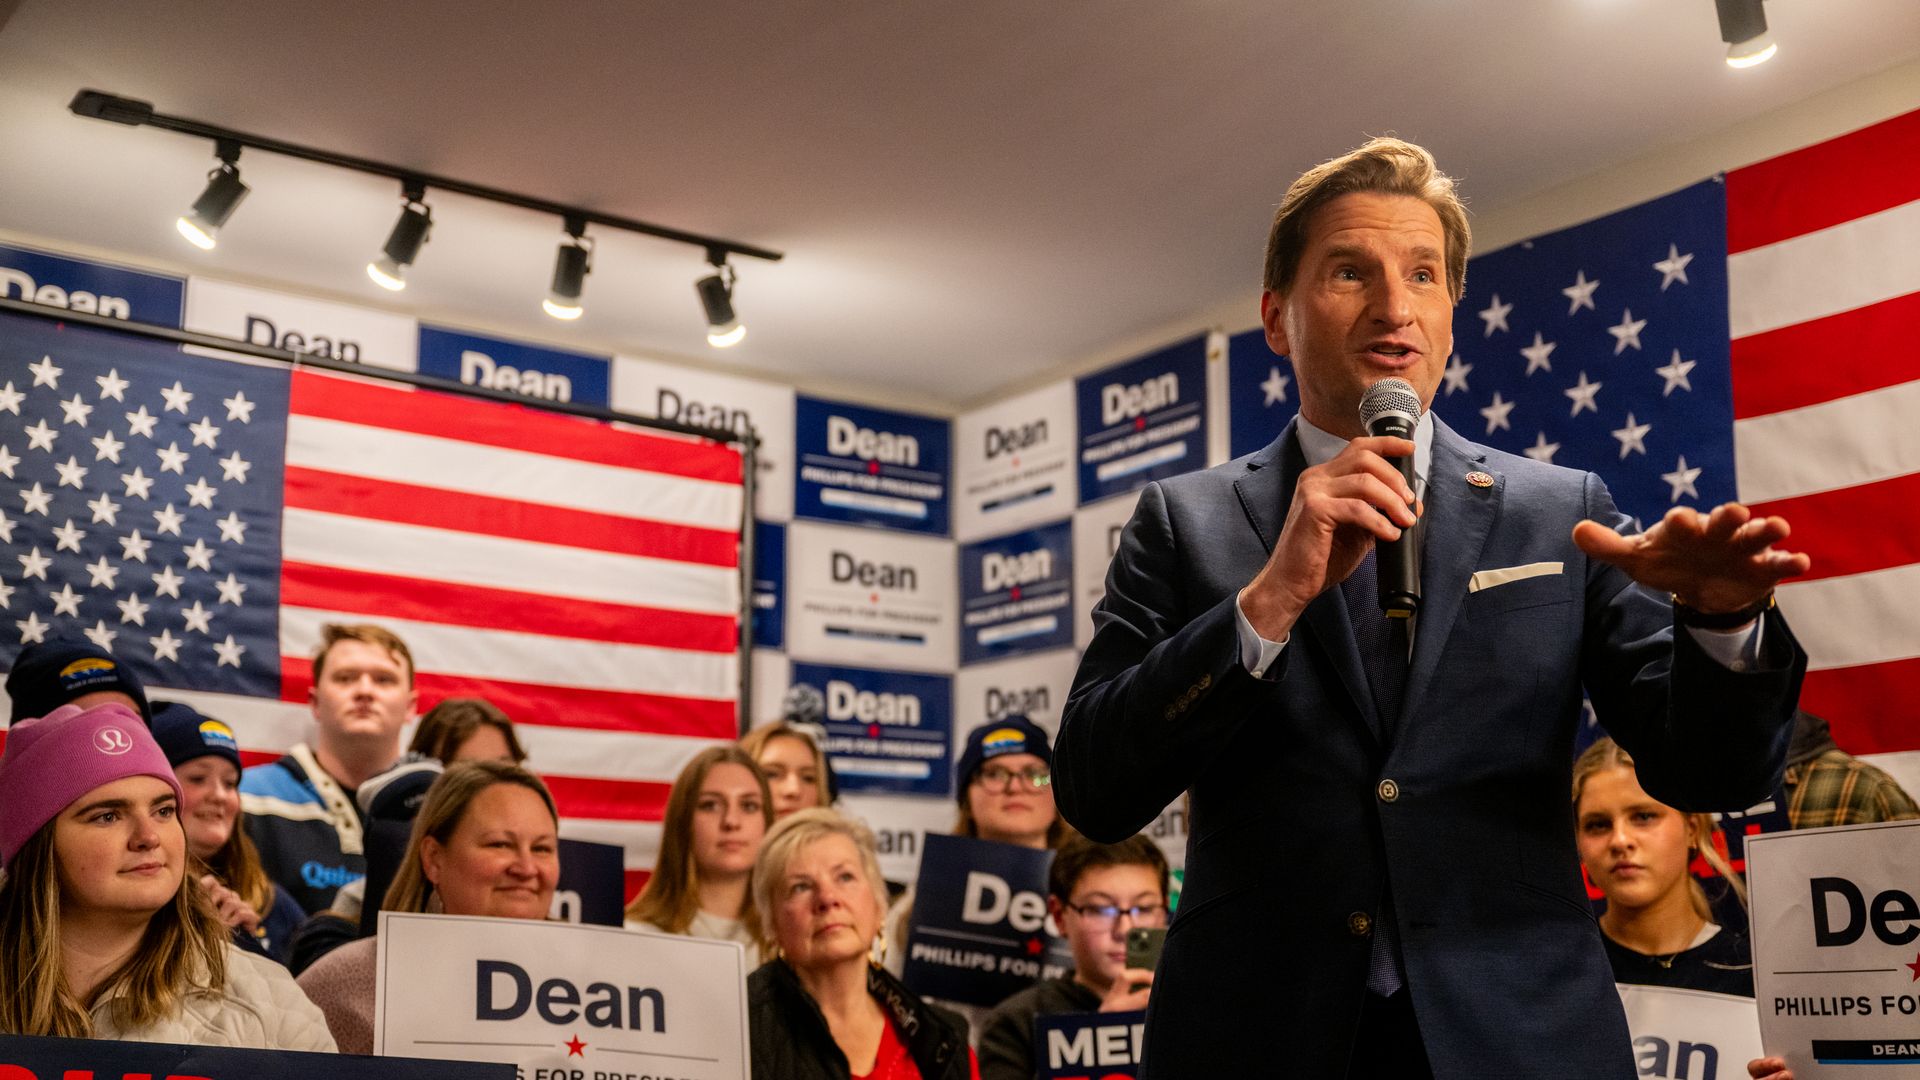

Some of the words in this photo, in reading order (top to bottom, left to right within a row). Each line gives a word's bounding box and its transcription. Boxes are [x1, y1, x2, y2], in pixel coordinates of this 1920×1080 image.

[460, 350, 572, 403] Dean
[1102, 372, 1179, 426] Dean
[827, 415, 919, 467] Dean
[985, 418, 1047, 460] Dean
[831, 550, 917, 591] Dean
[982, 548, 1052, 592] Dean
[826, 680, 921, 726] Dean
[986, 686, 1050, 719] Dean
[877, 829, 915, 855] an
[962, 871, 1059, 937] De
[1810, 877, 1920, 947] De
[911, 943, 996, 972] PHILLIPS
[1000, 956, 1040, 977] FOR
[476, 959, 666, 1033] Dean
[1775, 996, 1873, 1016] PHILLIPS
[1881, 994, 1920, 1015] FO
[1633, 1035, 1718, 1080] an
